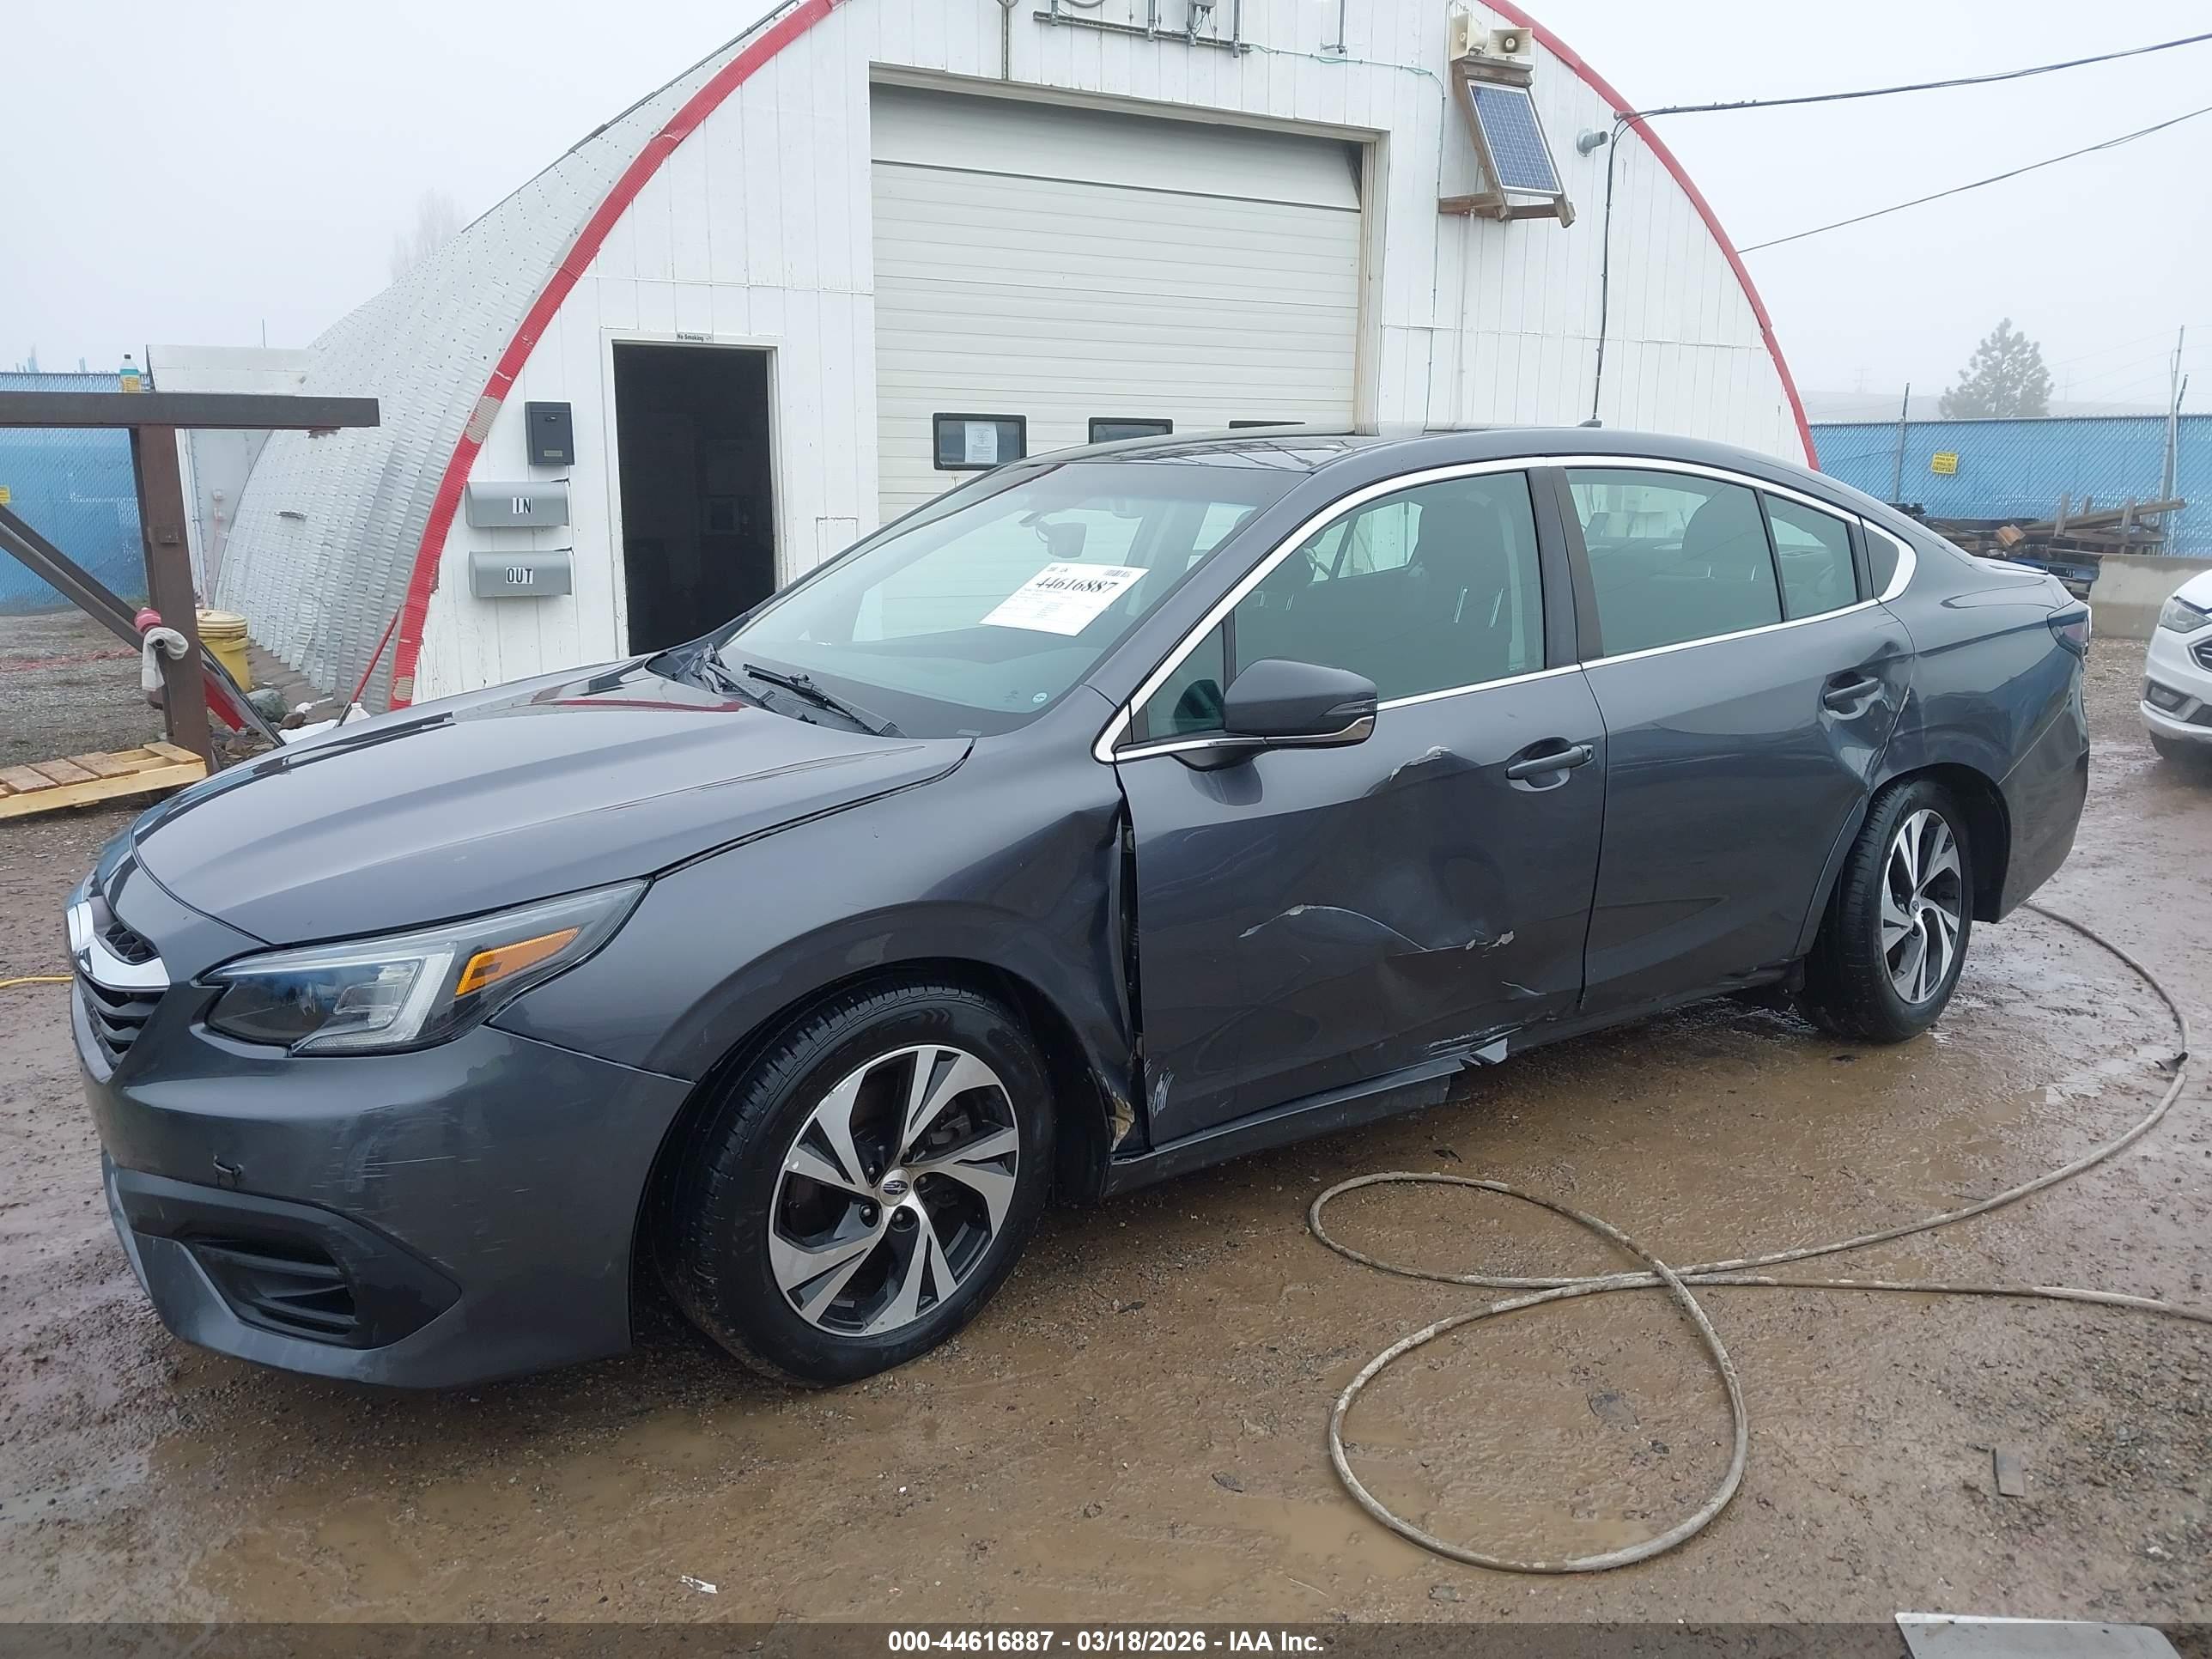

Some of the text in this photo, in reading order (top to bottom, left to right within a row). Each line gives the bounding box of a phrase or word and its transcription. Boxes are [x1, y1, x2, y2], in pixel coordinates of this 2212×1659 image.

[684, 334, 704, 343] Smoking
[516, 498, 532, 514] IN
[507, 568, 532, 583] OUT
[1036, 576, 1119, 594] 44616887
